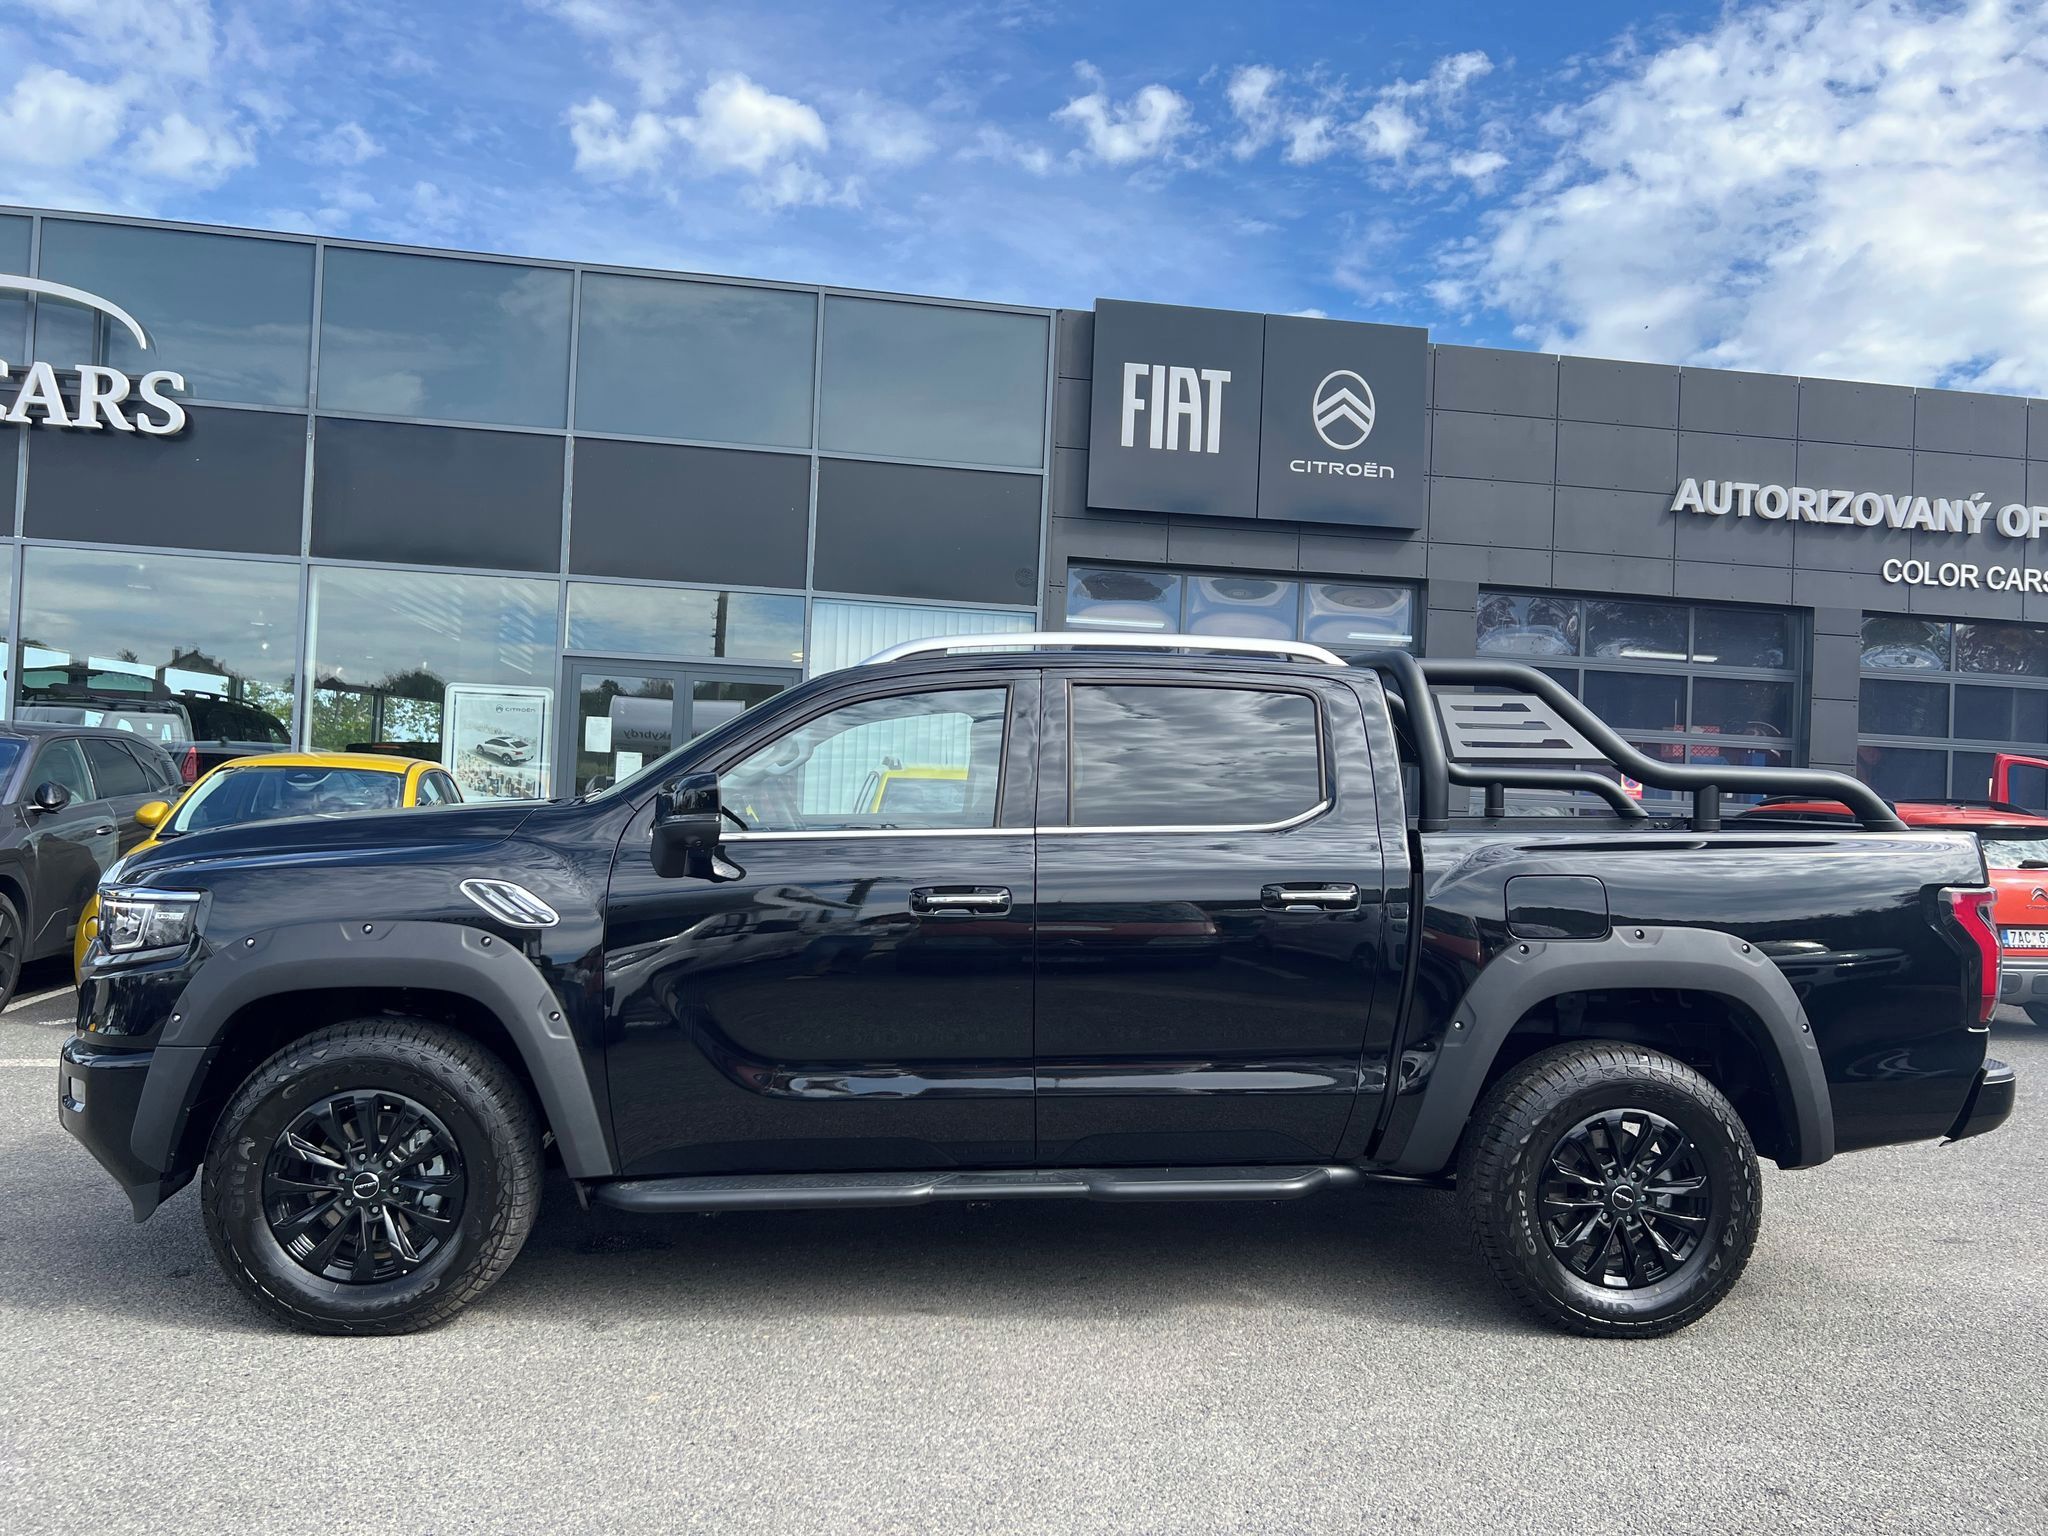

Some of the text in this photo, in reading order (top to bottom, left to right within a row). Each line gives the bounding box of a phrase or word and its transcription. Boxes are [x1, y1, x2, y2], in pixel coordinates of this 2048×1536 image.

[1120, 362, 1232, 454] FIAT
[1289, 459, 1395, 479] CITROËN
[1670, 478, 2048, 539] AUTORIZOVANÝ OP
[1882, 558, 1980, 589] COLOR
[2010, 931, 2031, 944] 7AC
